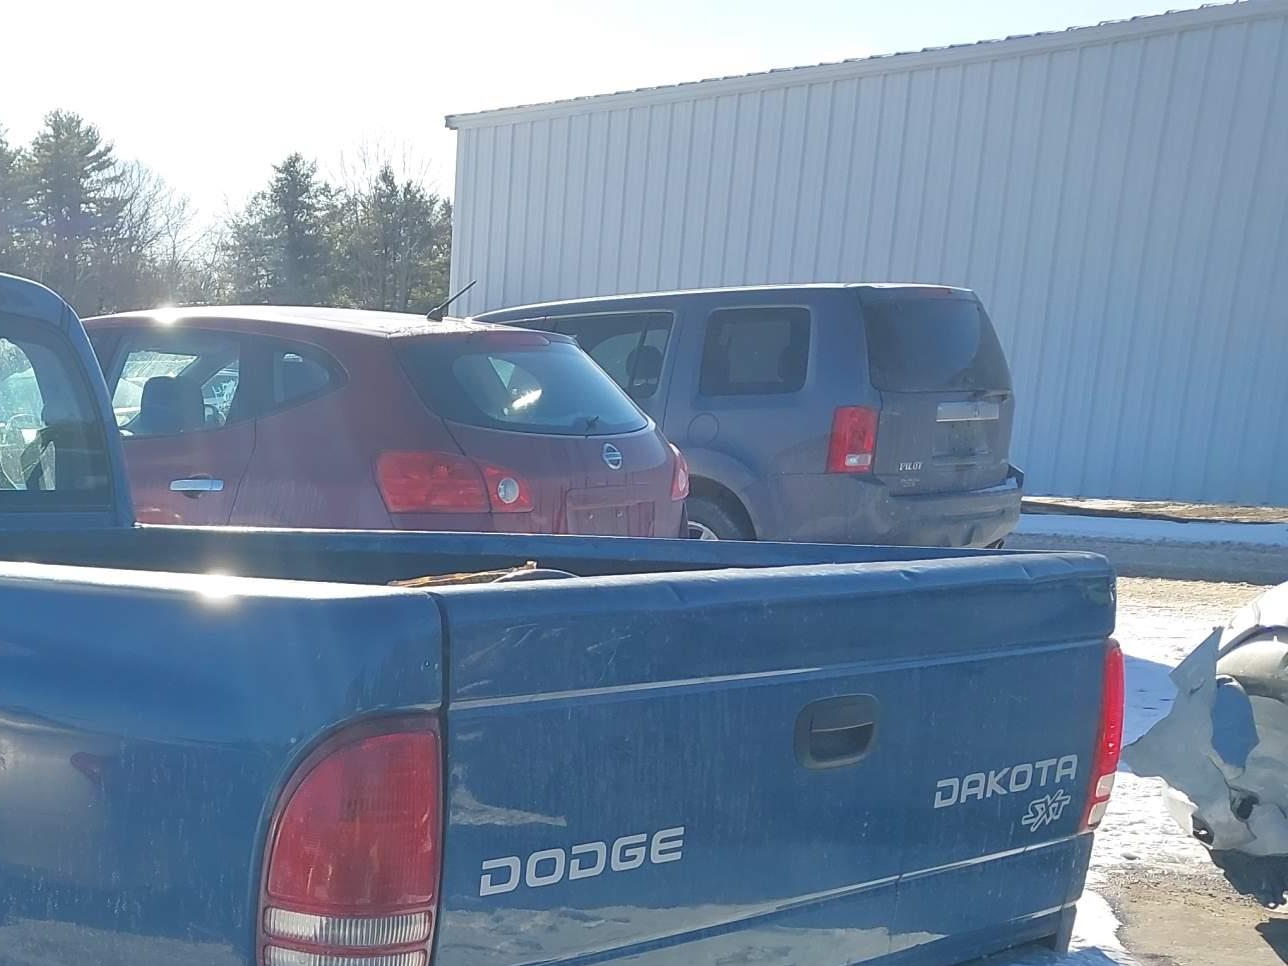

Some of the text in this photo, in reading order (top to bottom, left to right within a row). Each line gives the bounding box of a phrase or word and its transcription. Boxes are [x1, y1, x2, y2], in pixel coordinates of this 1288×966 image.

[899, 461, 923, 471] PILOT
[933, 754, 1078, 809] DAKOTA
[1021, 789, 1071, 832] SXT
[479, 826, 685, 897] DODGE
